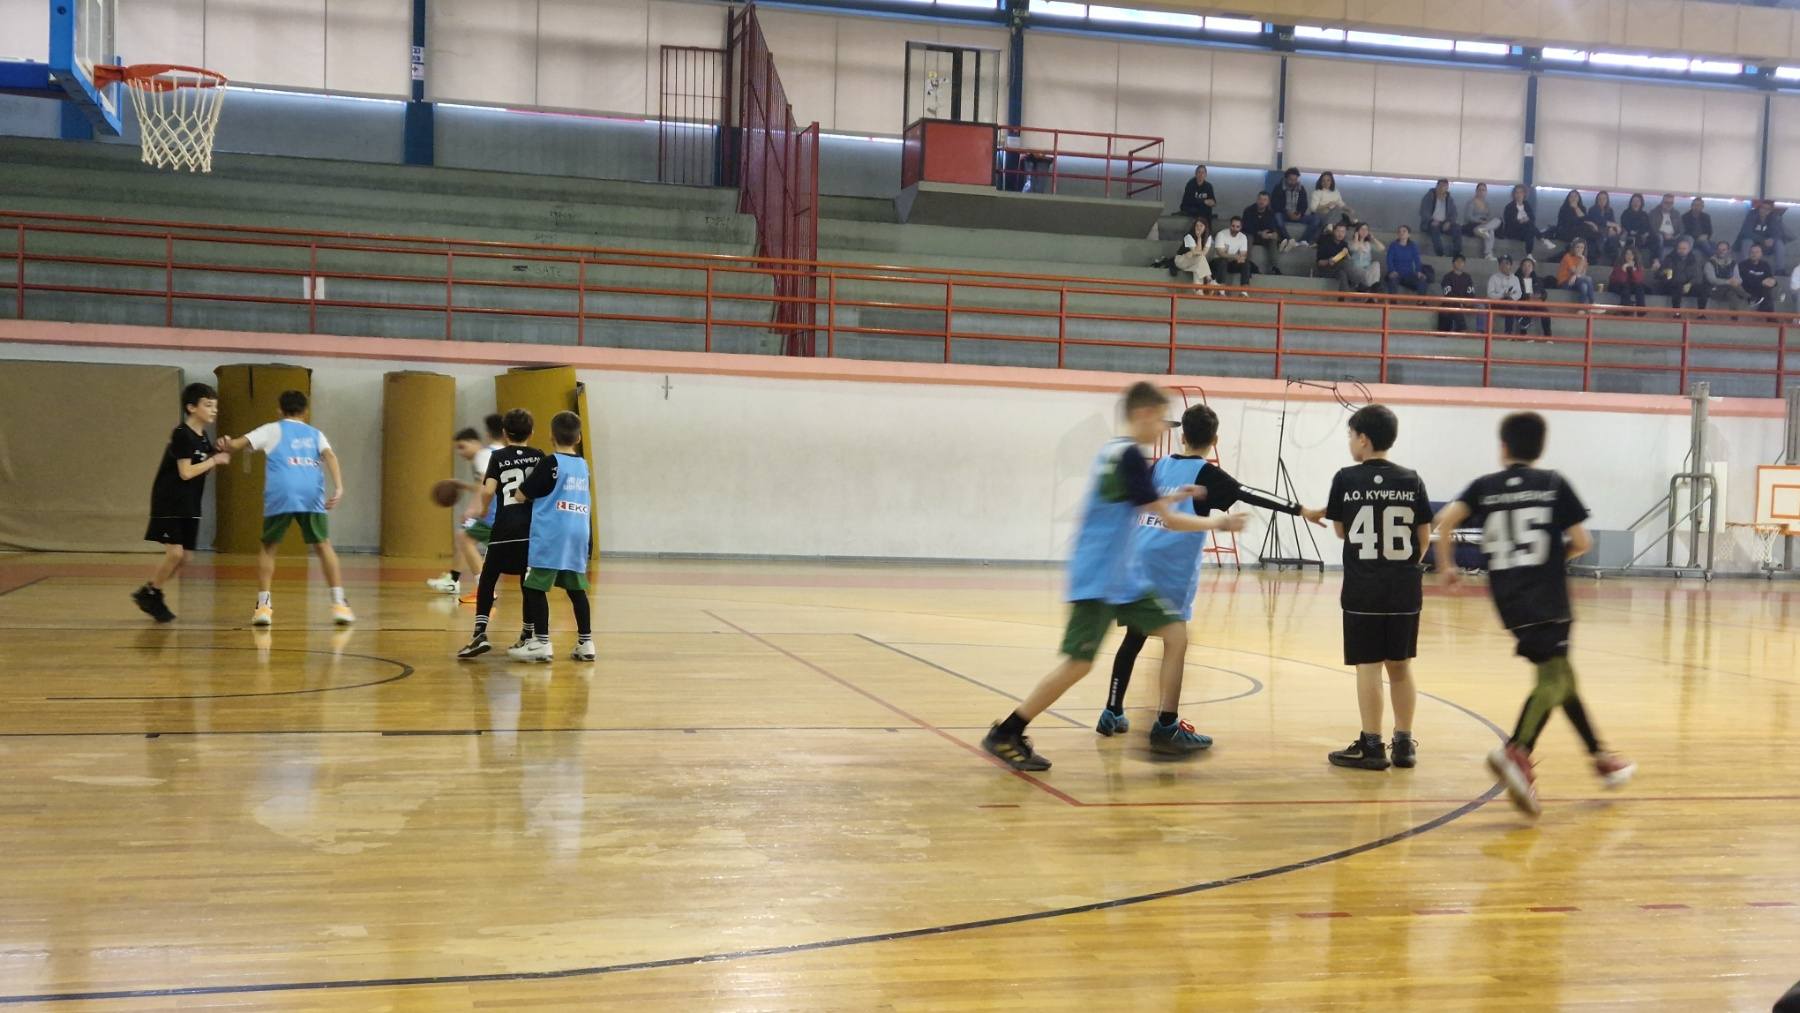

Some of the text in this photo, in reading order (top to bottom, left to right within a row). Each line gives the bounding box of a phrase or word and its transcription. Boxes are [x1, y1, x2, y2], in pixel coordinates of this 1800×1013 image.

[500, 467, 535, 506] 2
[1366, 490, 1415, 502] ΚΥΨΕΛΗΣ
[1348, 505, 1415, 560] 46
[1481, 506, 1555, 571] 45
